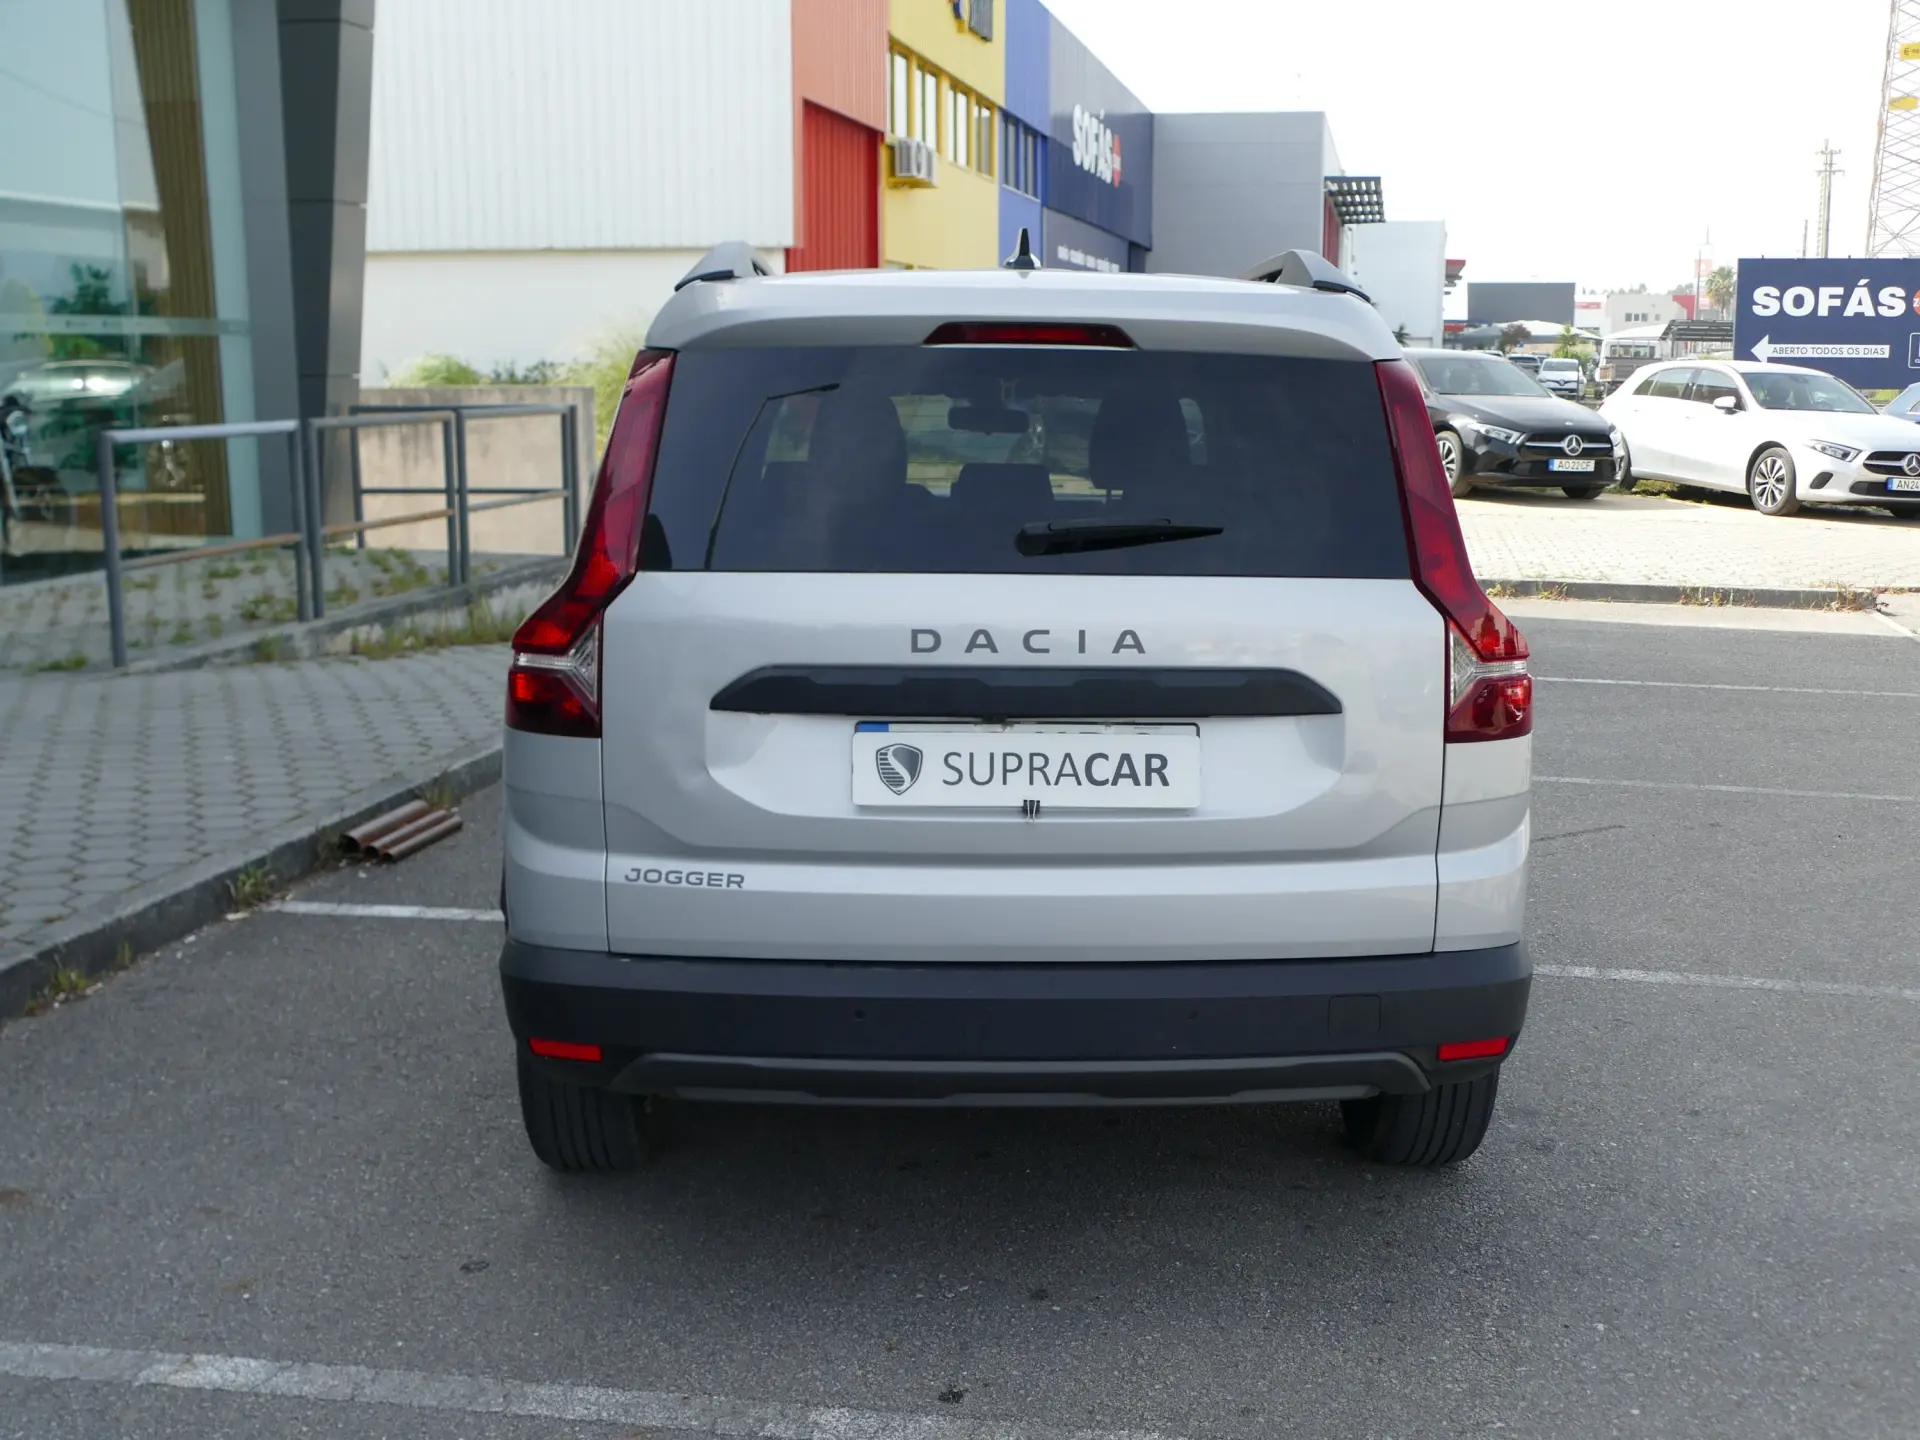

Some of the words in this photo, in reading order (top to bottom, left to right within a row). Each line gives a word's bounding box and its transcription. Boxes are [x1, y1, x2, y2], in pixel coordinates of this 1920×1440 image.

[1752, 278, 1906, 317] SOFÁS
[1772, 346, 1808, 355] ABERTO
[1811, 346, 1844, 355] TODOS
[1847, 347, 1861, 355] OS
[1863, 347, 1886, 356] DIAS
[911, 628, 1146, 654] DACIA
[942, 751, 1170, 787] SUPRACAR
[624, 868, 745, 889] JOGGER
